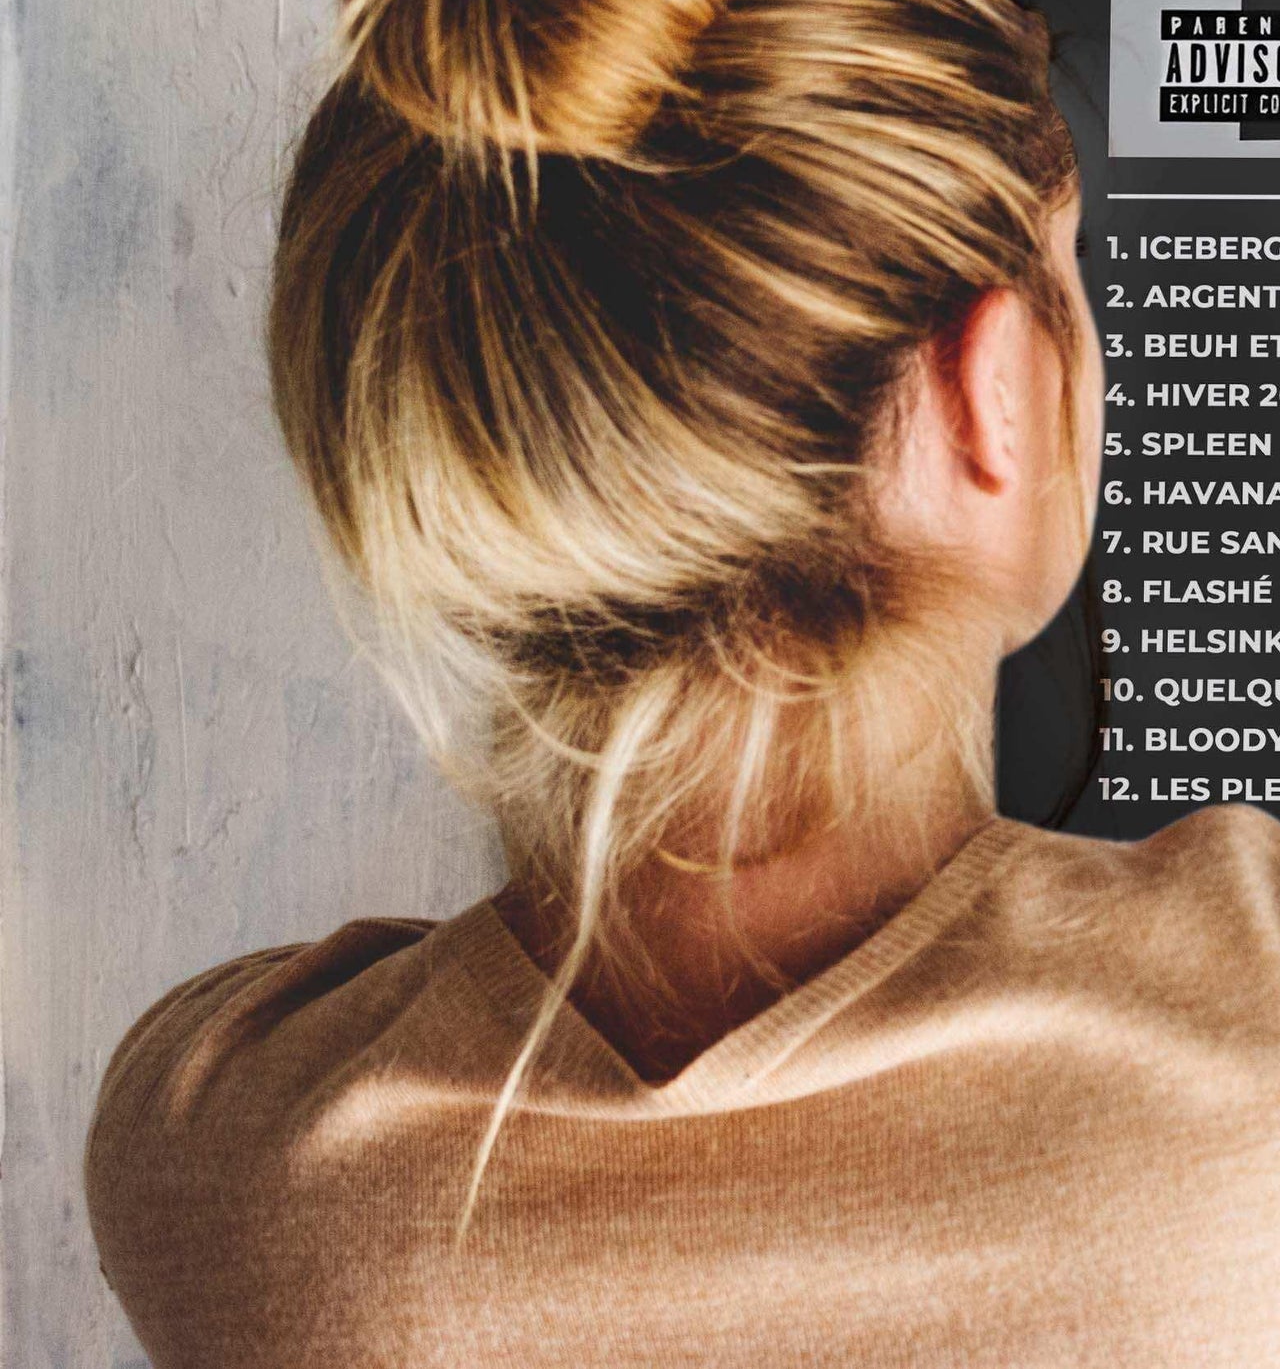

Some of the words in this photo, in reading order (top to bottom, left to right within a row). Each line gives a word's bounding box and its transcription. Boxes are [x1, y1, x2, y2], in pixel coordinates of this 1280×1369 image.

[1169, 93, 1249, 114] EXPLICIT
[1106, 235, 1129, 260] 1.
[1105, 284, 1134, 309] 2.
[1104, 333, 1134, 358] 3.
[1144, 333, 1238, 358] BEUH
[1104, 383, 1136, 407] 4.
[1146, 383, 1250, 407] HIVER
[1103, 431, 1132, 457] 5.
[1141, 431, 1272, 457] SPLEEN
[1103, 480, 1133, 506] 6.
[1102, 530, 1132, 555] 7.
[1142, 530, 1211, 555] RUE
[1102, 579, 1132, 604] 8.
[1143, 574, 1273, 604] FLASHÉ
[1101, 628, 1130, 654] 9.
[1100, 677, 1144, 703] 10.
[1099, 727, 1135, 752] 11.
[1097, 776, 1140, 802] 12.
[1150, 777, 1211, 802] LES
